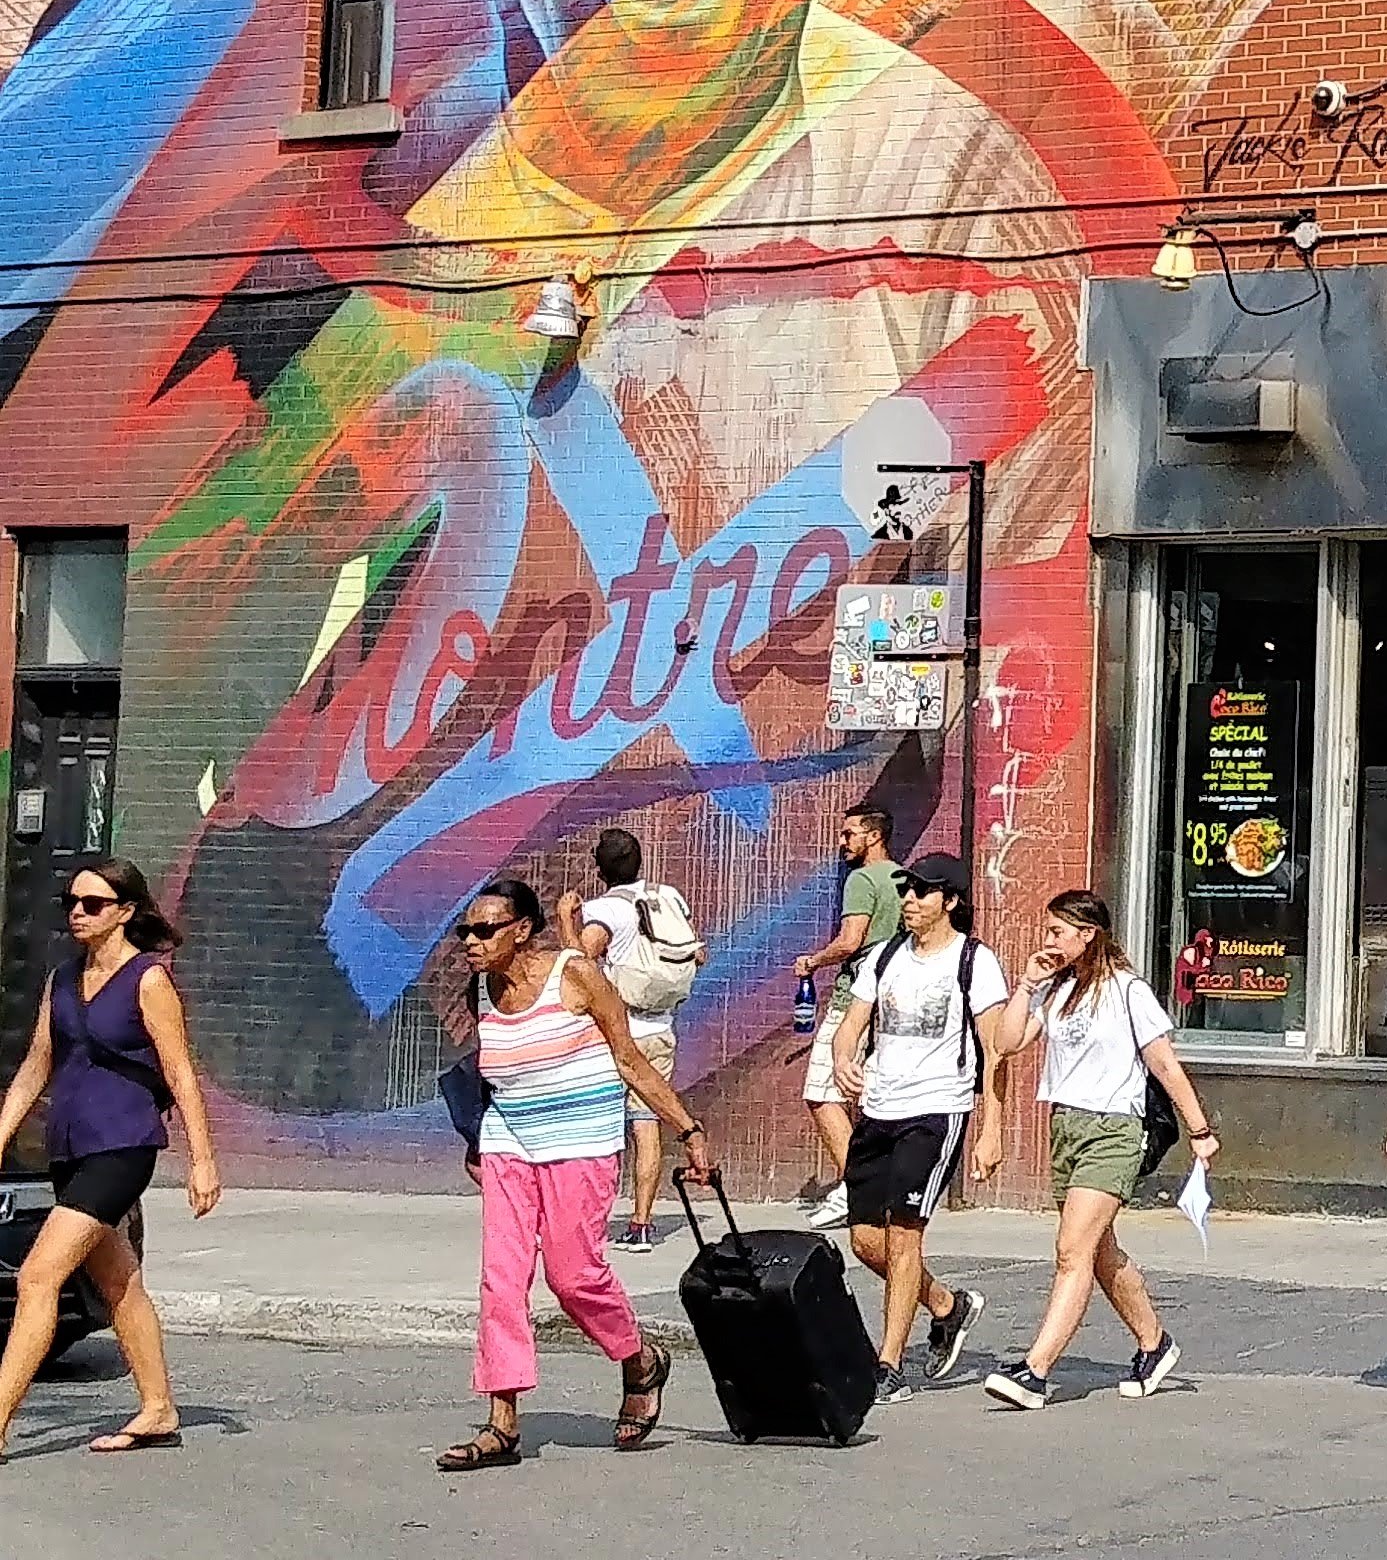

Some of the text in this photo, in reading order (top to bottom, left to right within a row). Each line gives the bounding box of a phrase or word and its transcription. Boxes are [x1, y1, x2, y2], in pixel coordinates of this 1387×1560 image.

[1208, 720, 1269, 742] SPÉCIAL
[1218, 940, 1287, 957] Rôtisserie
[1239, 966, 1291, 990] Rico
